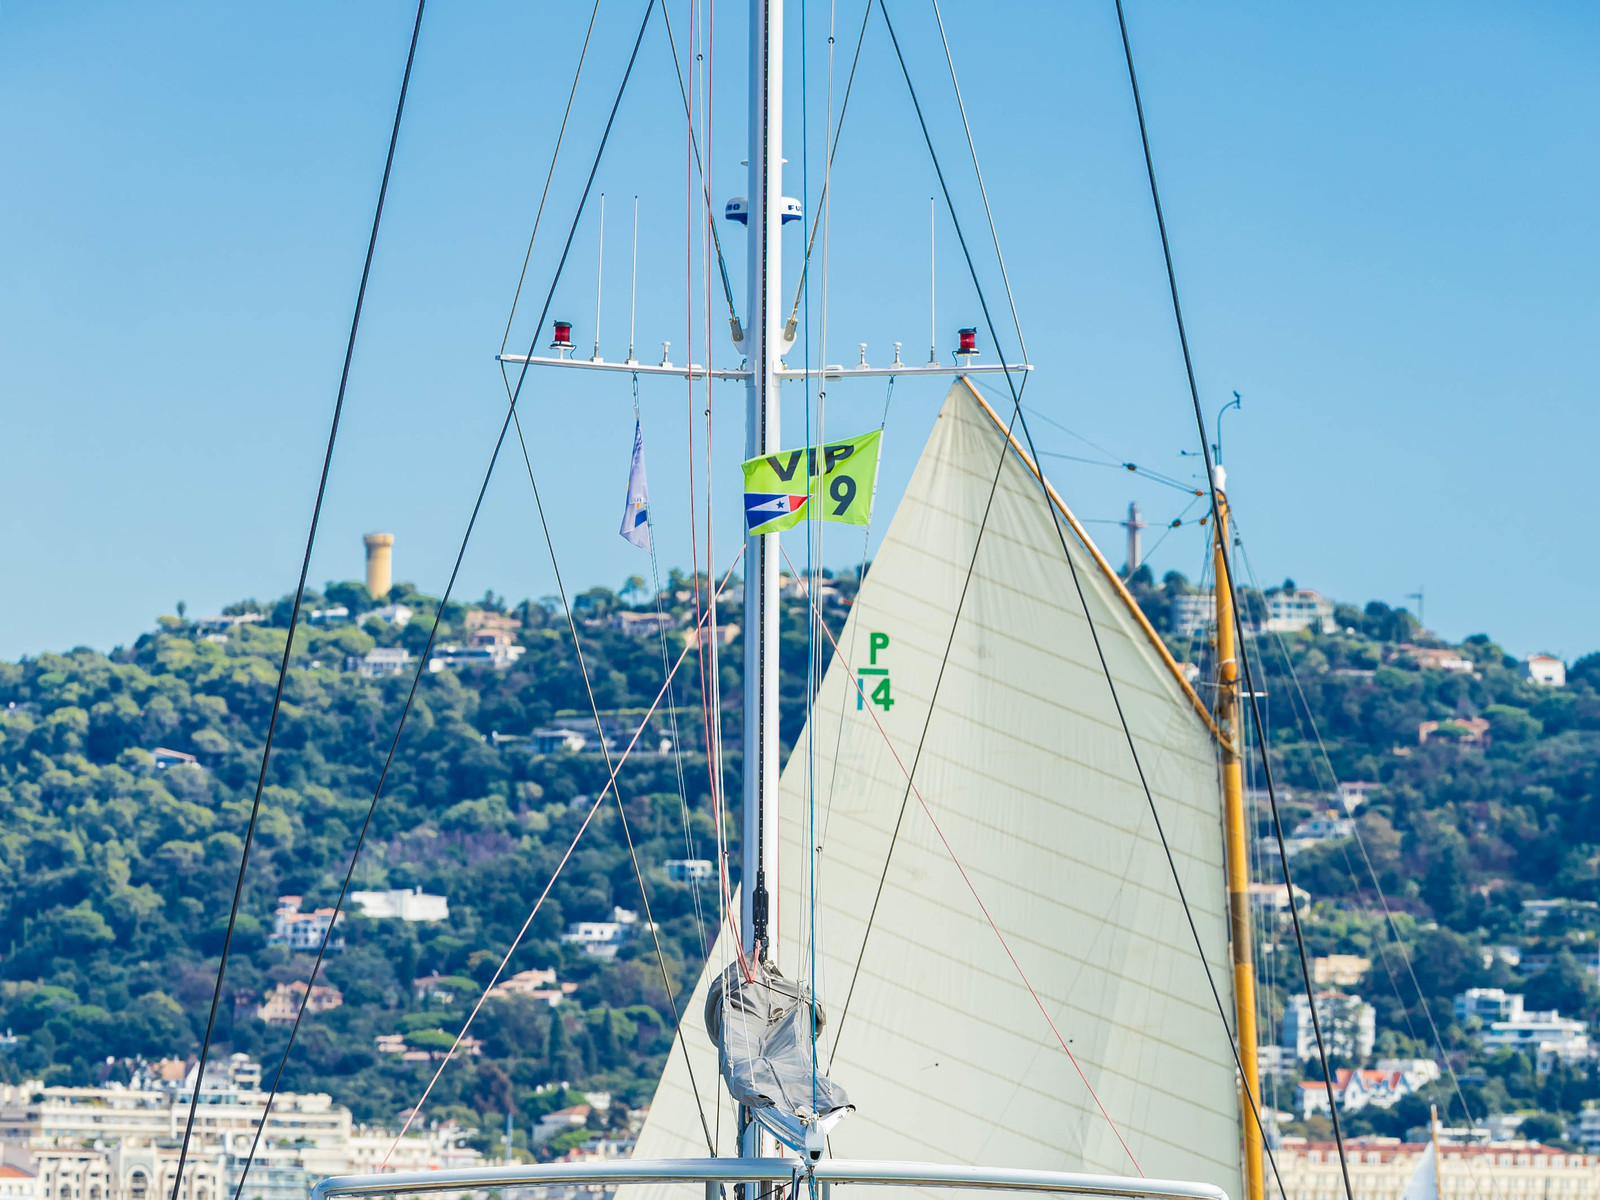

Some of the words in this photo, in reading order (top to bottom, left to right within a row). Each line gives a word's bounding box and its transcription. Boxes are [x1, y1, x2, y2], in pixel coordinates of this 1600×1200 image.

[766, 445, 855, 482] VIP
[829, 475, 857, 516] 9
[870, 632, 890, 665] P
